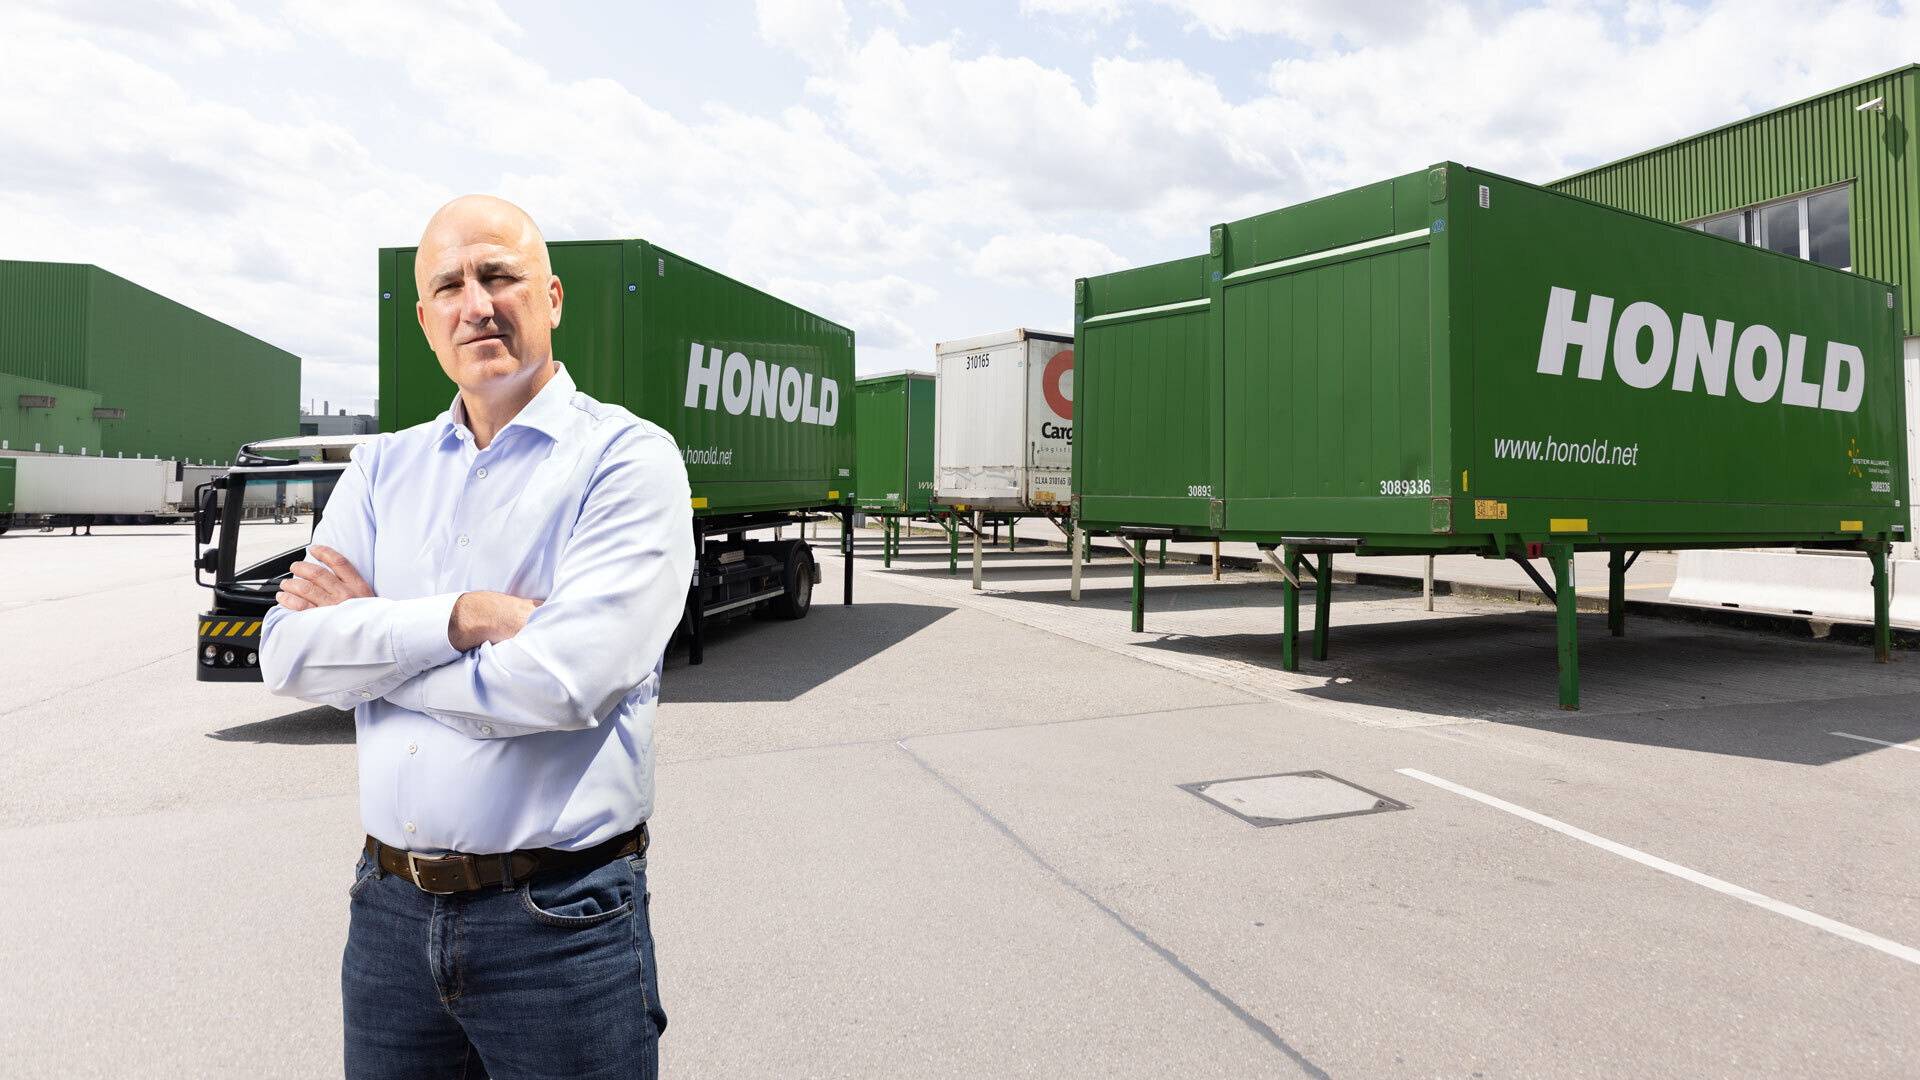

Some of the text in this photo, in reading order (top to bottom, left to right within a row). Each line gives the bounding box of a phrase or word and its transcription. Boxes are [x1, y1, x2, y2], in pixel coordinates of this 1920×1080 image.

[966, 353, 990, 370] 310165
[1536, 285, 1865, 413] HONOLD
[684, 341, 839, 427] HONOLD
[1494, 435, 1639, 466] www.honold.net
[1380, 479, 1432, 496] 3089336
